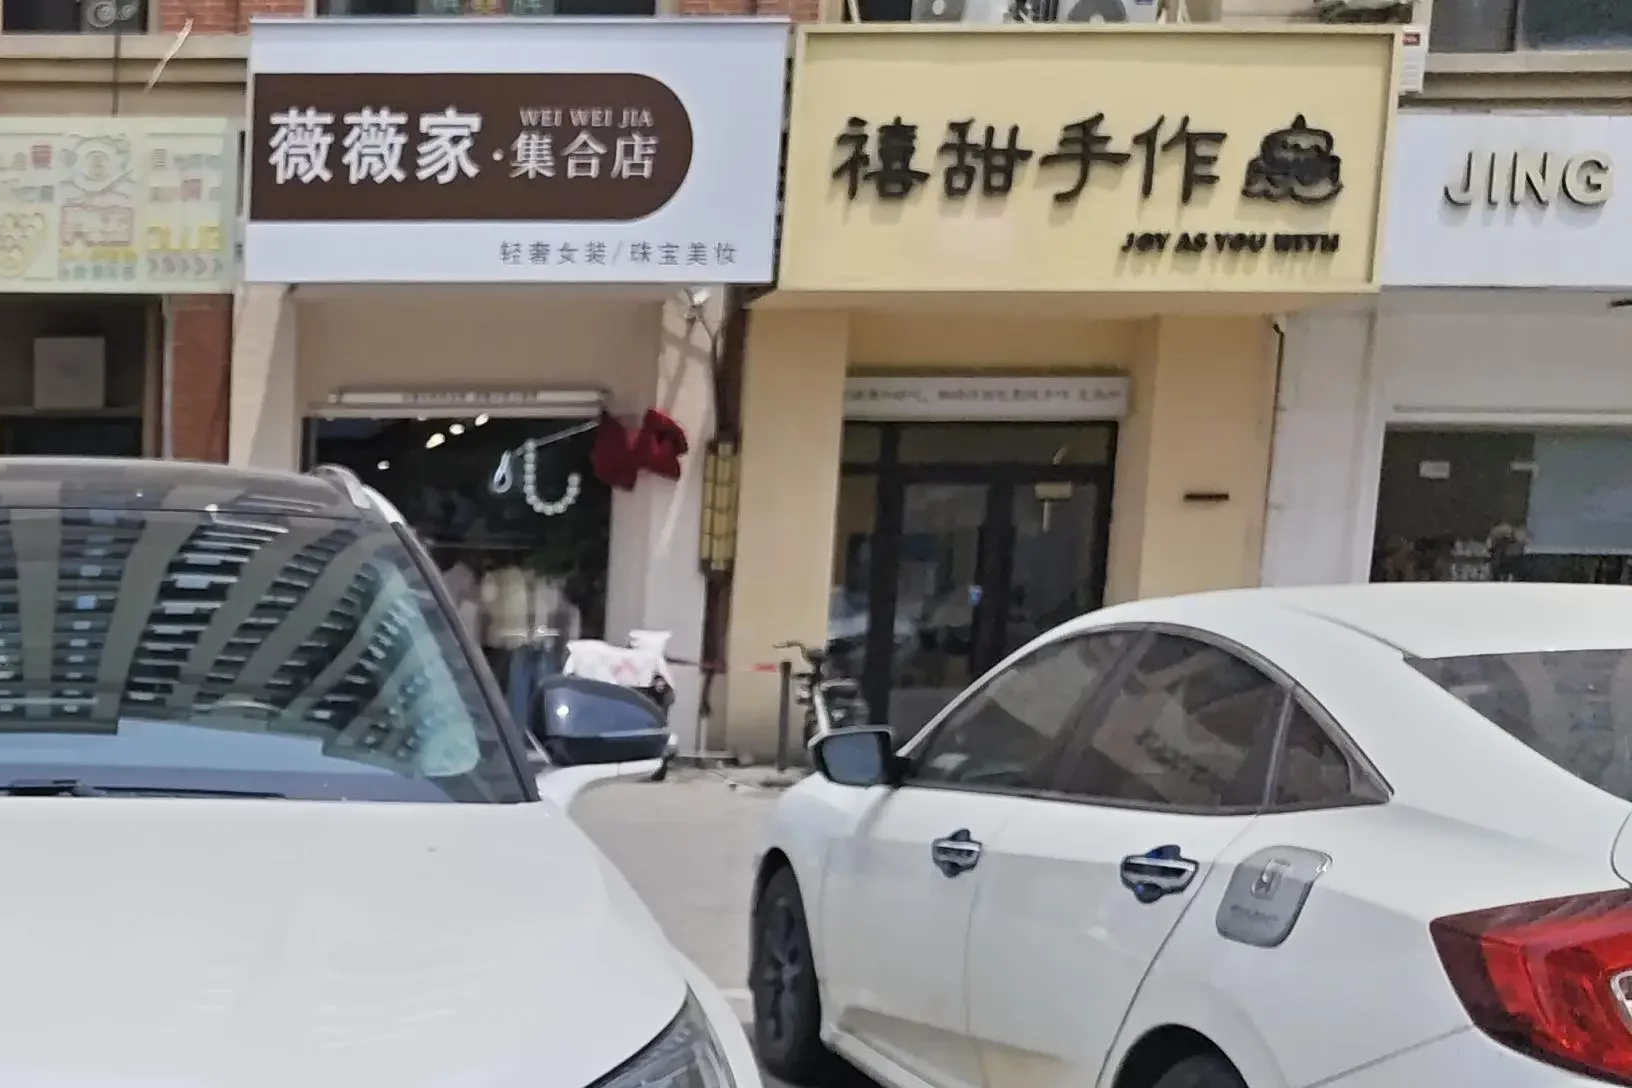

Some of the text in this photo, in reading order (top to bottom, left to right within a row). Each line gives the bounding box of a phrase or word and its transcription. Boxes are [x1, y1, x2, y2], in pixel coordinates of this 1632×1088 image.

[519, 107, 655, 129] WEI WEI JIA
[831, 112, 1228, 204] 禧甜手作
[1443, 150, 1614, 207] JING
[1120, 232, 1171, 253] JOY
[1174, 232, 1209, 253] AS
[1214, 232, 1267, 253] YOU
